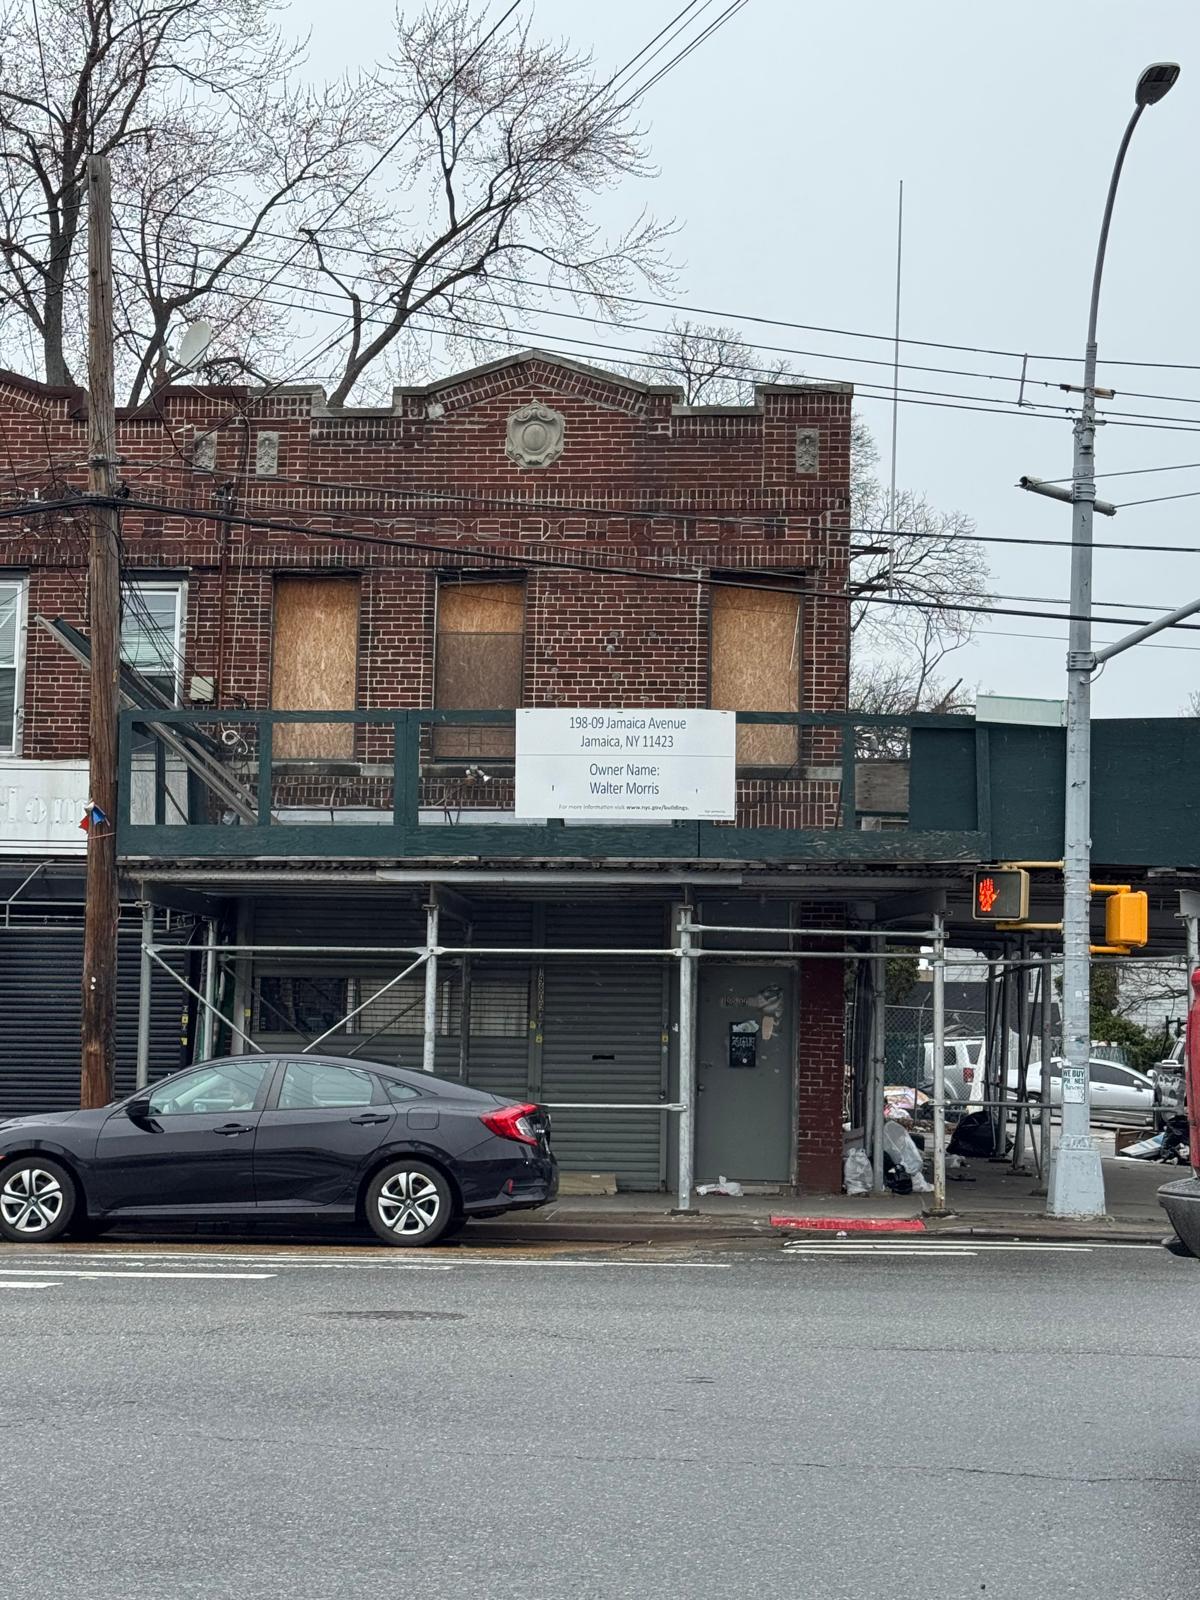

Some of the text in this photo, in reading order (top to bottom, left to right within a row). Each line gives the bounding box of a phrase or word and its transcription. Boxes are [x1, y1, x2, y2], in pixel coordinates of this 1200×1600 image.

[569, 716, 687, 730] 198-09 Jamaica Avenue
[580, 735, 674, 750] Jamaica, NY 11423
[589, 763, 660, 776] Owner Name:
[589, 781, 660, 795] Walter Morris
